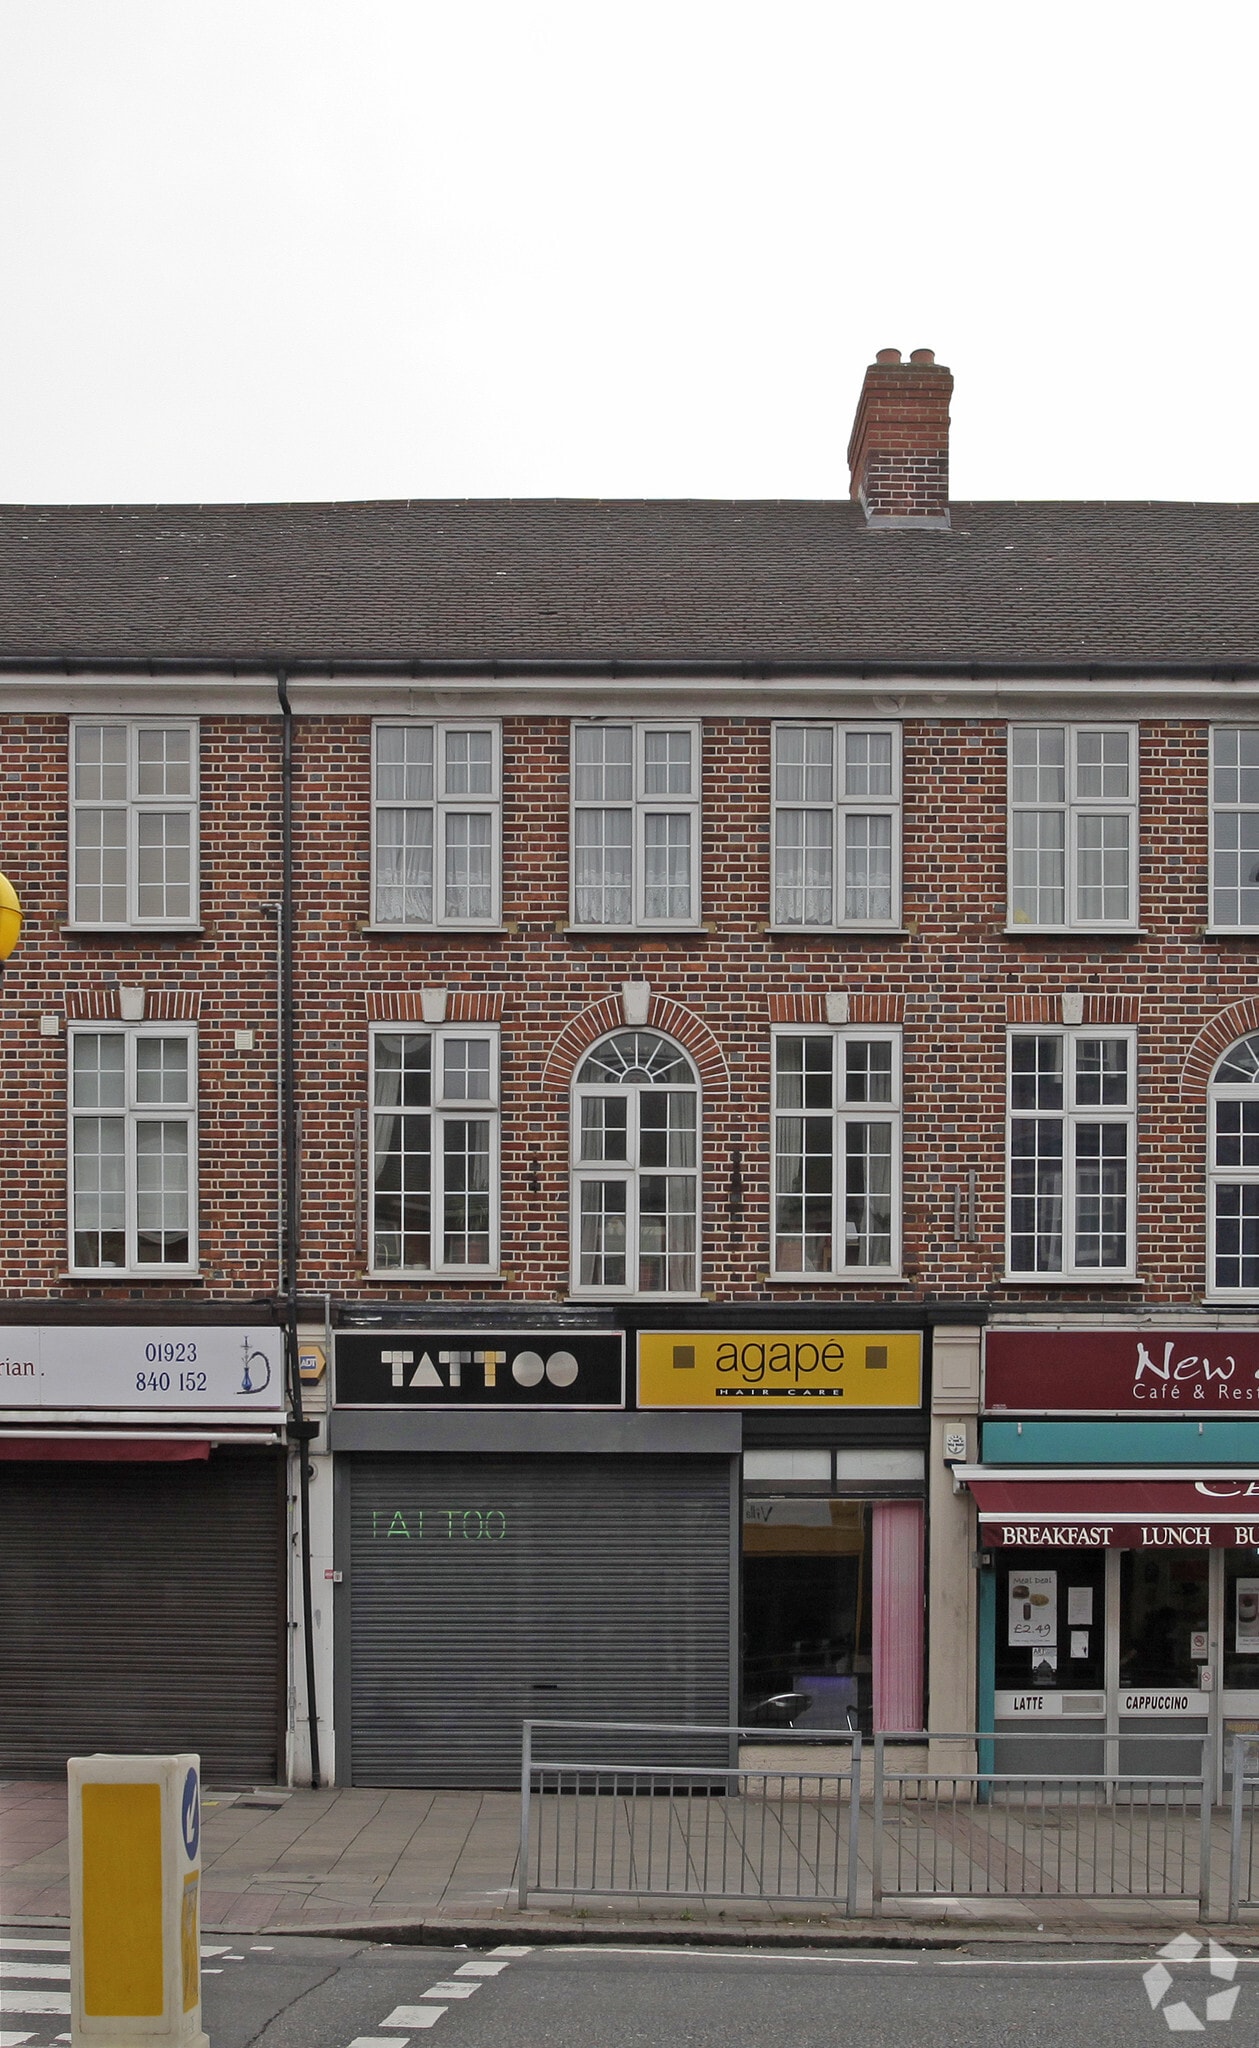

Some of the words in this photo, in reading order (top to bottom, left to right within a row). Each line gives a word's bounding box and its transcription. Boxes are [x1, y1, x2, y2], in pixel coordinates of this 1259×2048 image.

[145, 1343, 197, 1362] 01923
[716, 1338, 845, 1383] agapé
[1134, 1341, 1236, 1381] New
[381, 1351, 579, 1387] TATTOO
[136, 1372, 170, 1391] 840
[180, 1372, 207, 1391] 152
[1132, 1383, 1180, 1399] Café
[1193, 1384, 1205, 1399] &
[1002, 1527, 1113, 1545] BREAKFAST
[1141, 1527, 1212, 1545] LUNCH
[1014, 1624, 1051, 1638] £2.49
[1013, 1696, 1043, 1710] LATTE
[1126, 1696, 1188, 1710] CAPPUCCINO
